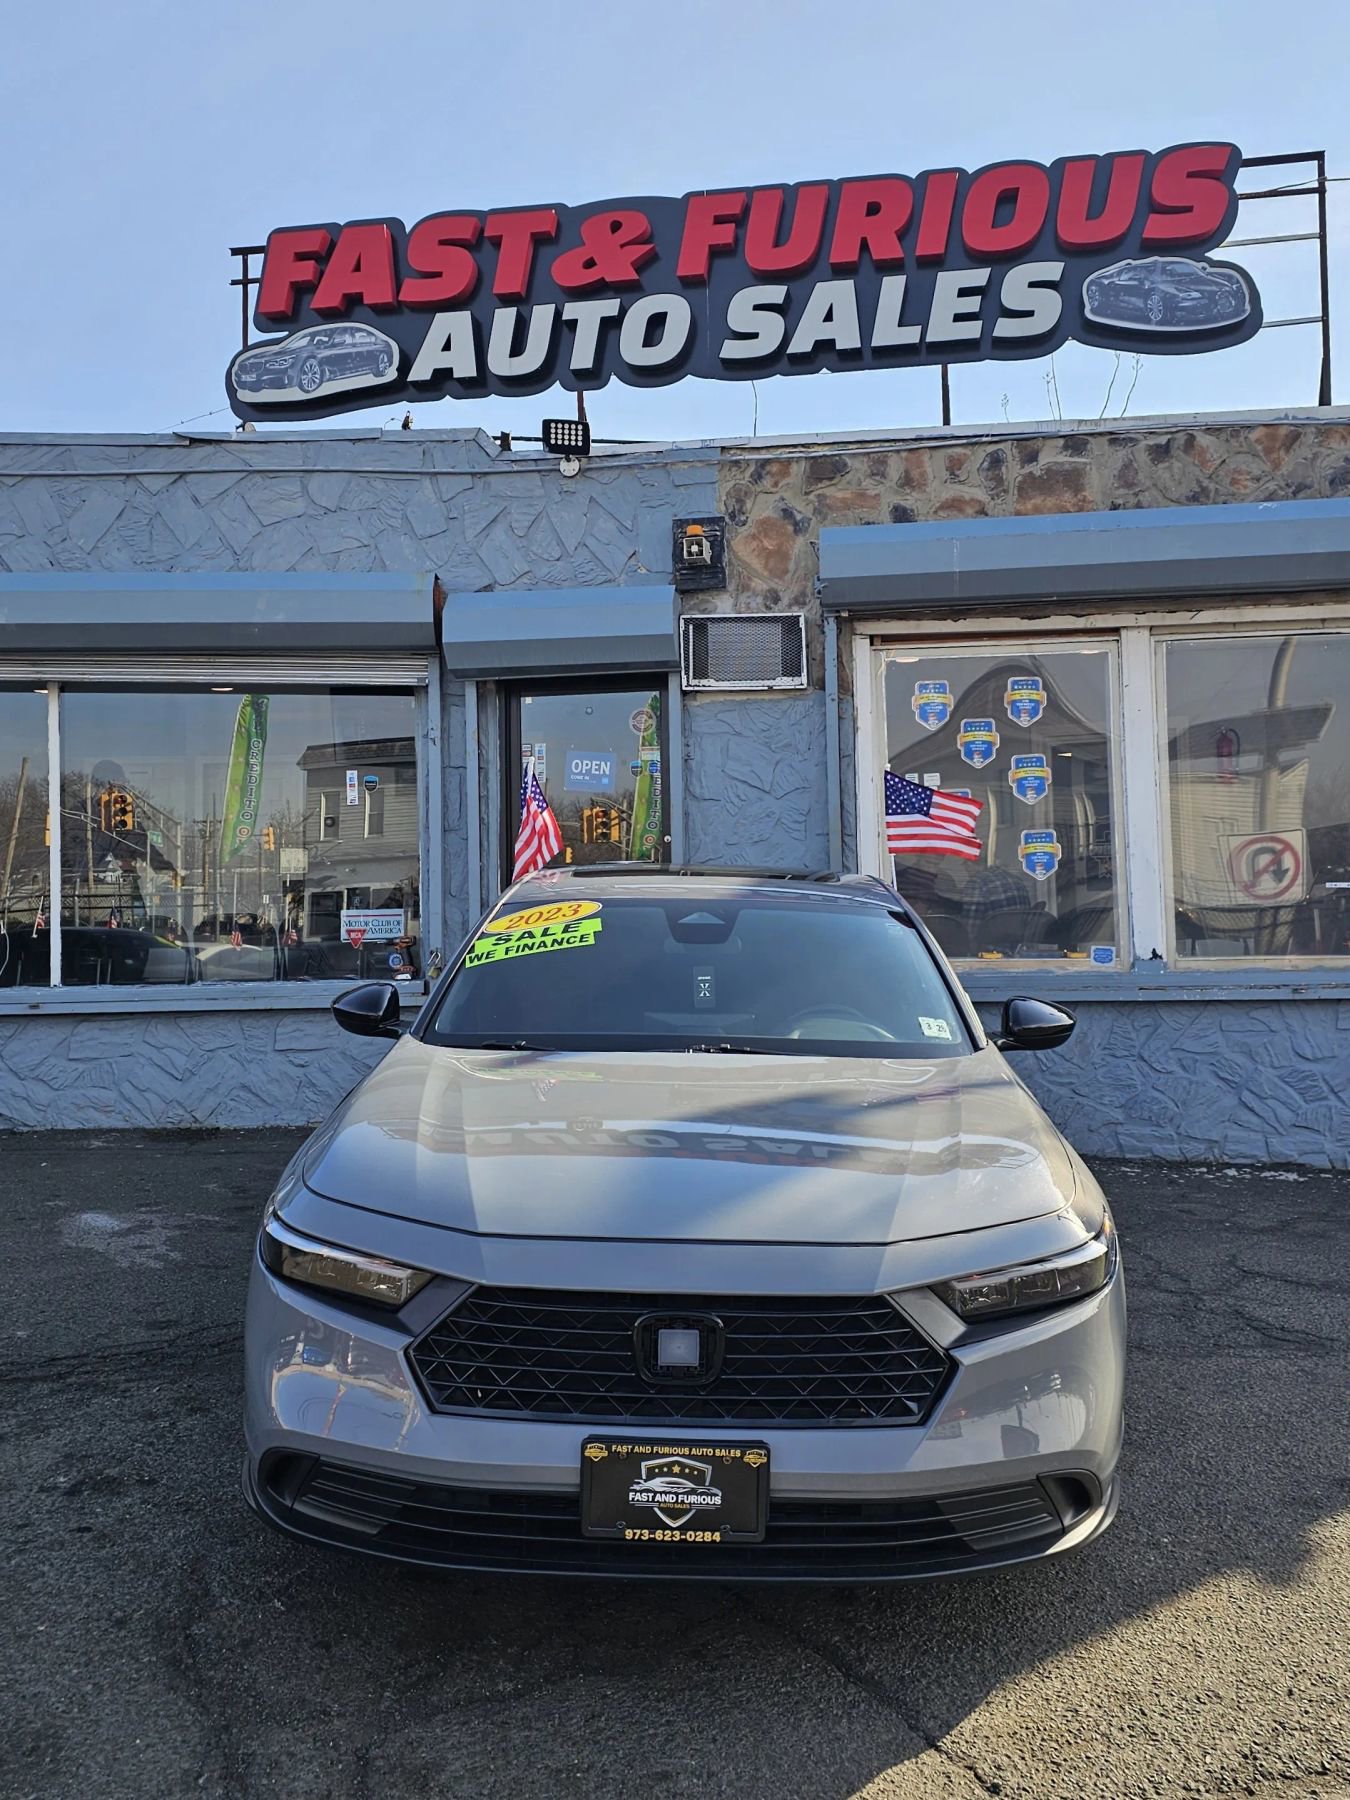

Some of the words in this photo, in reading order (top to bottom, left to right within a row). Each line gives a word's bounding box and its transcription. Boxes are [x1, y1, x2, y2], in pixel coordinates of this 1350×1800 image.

[258, 210, 558, 318] FAST
[551, 209, 656, 288] &
[676, 145, 1233, 284] FURIOUS
[407, 293, 691, 382] AUTO
[718, 262, 1065, 362] SALES
[571, 760, 610, 774] OPEN
[504, 903, 582, 930] 2023
[491, 922, 583, 946] SALE
[468, 949, 496, 964] WE
[504, 932, 590, 955] FINANCE
[611, 1444, 633, 1453] FAST
[633, 1445, 652, 1454] AND
[653, 1446, 690, 1455] FURIOUS
[691, 1447, 714, 1456] AUTO
[715, 1448, 741, 1457] SALES
[629, 1491, 654, 1502] FAST
[655, 1492, 677, 1503] AND
[678, 1493, 721, 1505] FURIOUS
[624, 1529, 721, 1543] 973-623-0284
